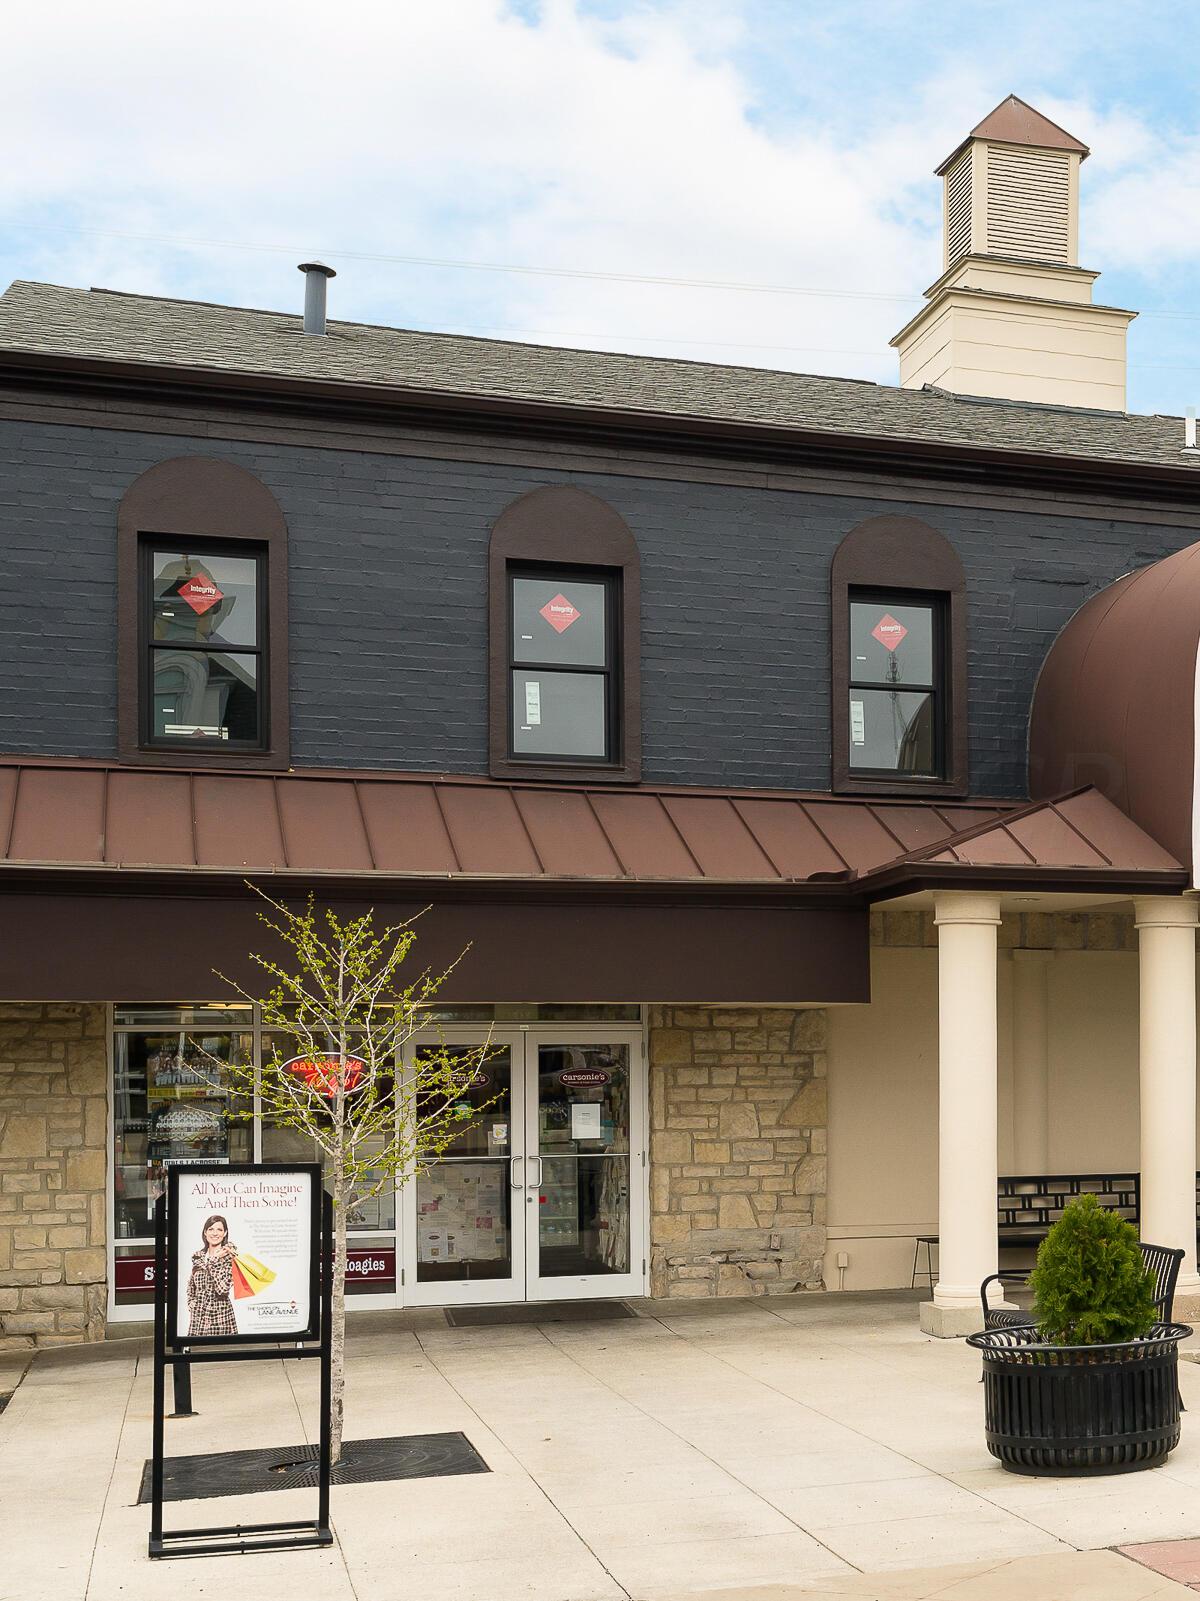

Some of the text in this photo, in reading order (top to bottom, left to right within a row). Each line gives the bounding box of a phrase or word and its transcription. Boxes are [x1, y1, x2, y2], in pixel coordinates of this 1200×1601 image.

[190, 585, 216, 595] Integrity
[562, 1073, 605, 1081] carsonie's
[191, 1182, 303, 1197] All You Can Imagine
[230, 1196, 259, 1208] Then
[261, 1196, 298, 1207] Some!
